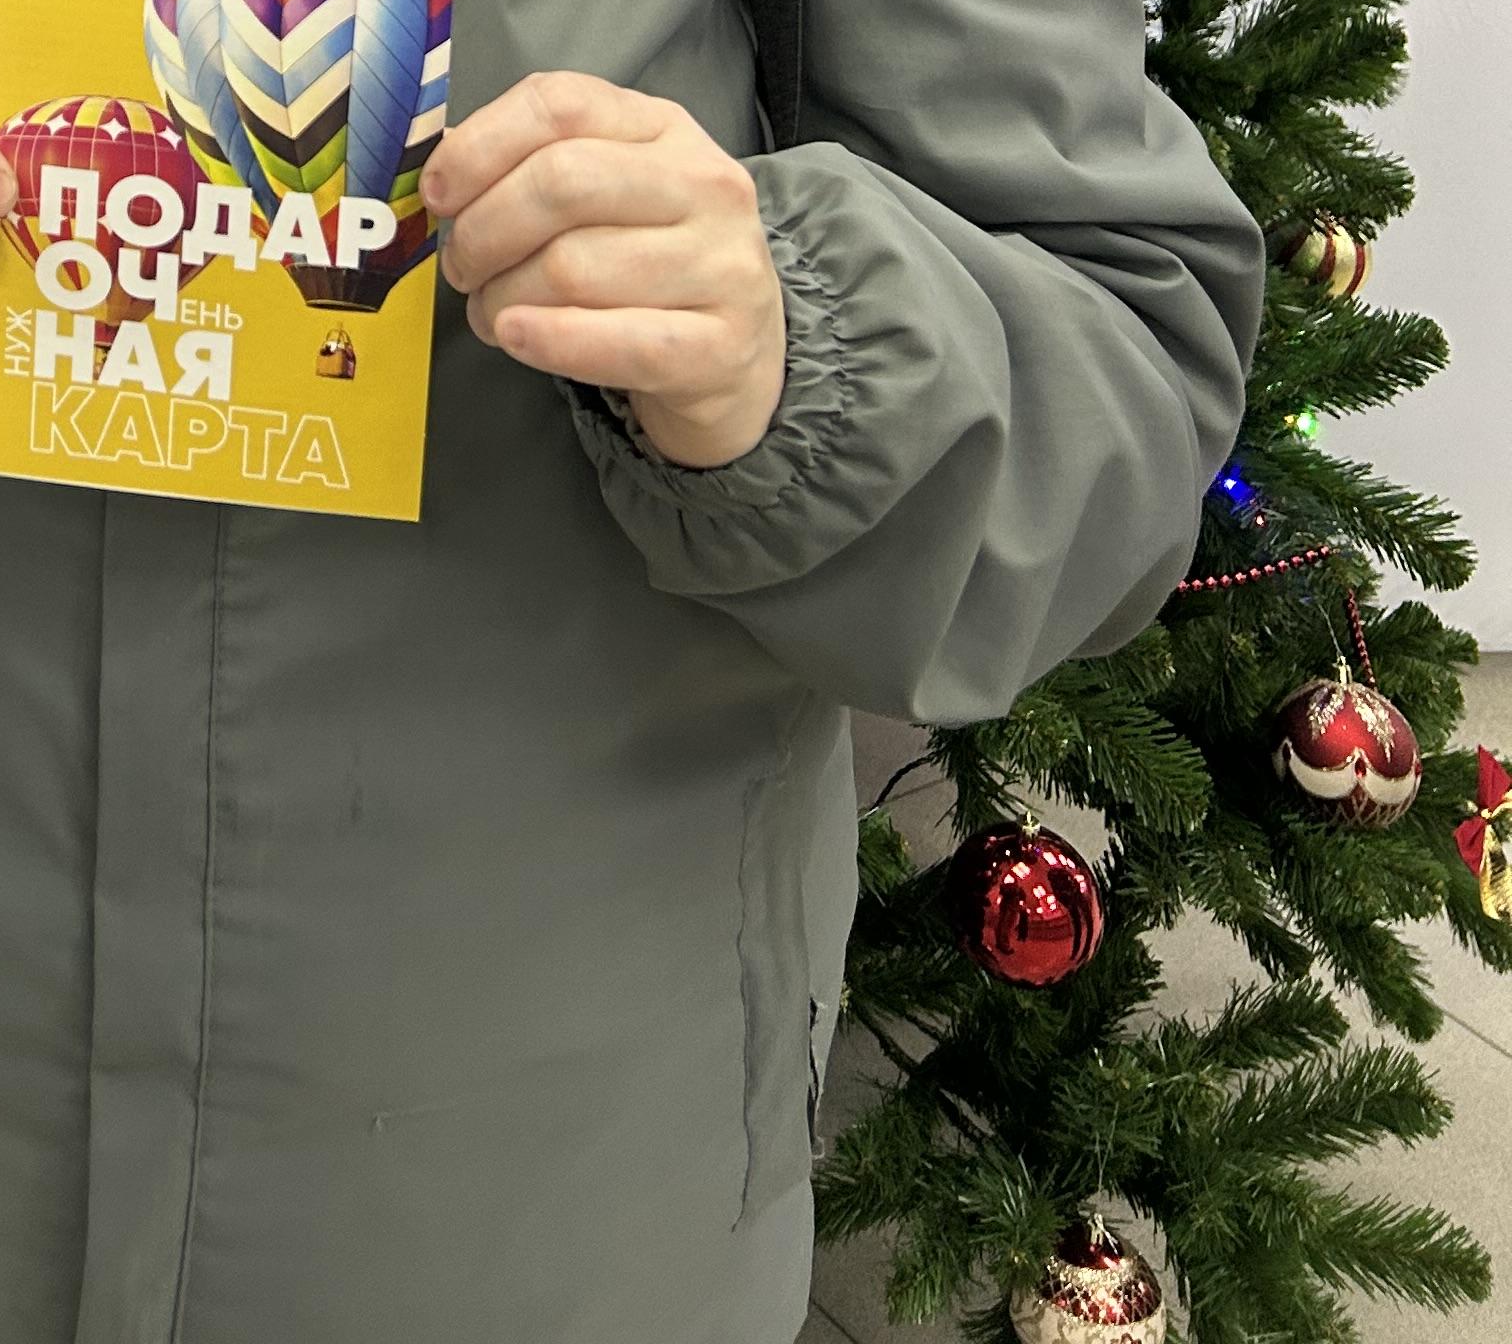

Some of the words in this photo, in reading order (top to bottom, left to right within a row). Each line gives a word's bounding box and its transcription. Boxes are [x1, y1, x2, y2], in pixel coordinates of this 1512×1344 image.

[39, 162, 398, 271] ПОДАР
[34, 239, 181, 322] ОЧ
[30, 381, 352, 489] КАРТА
